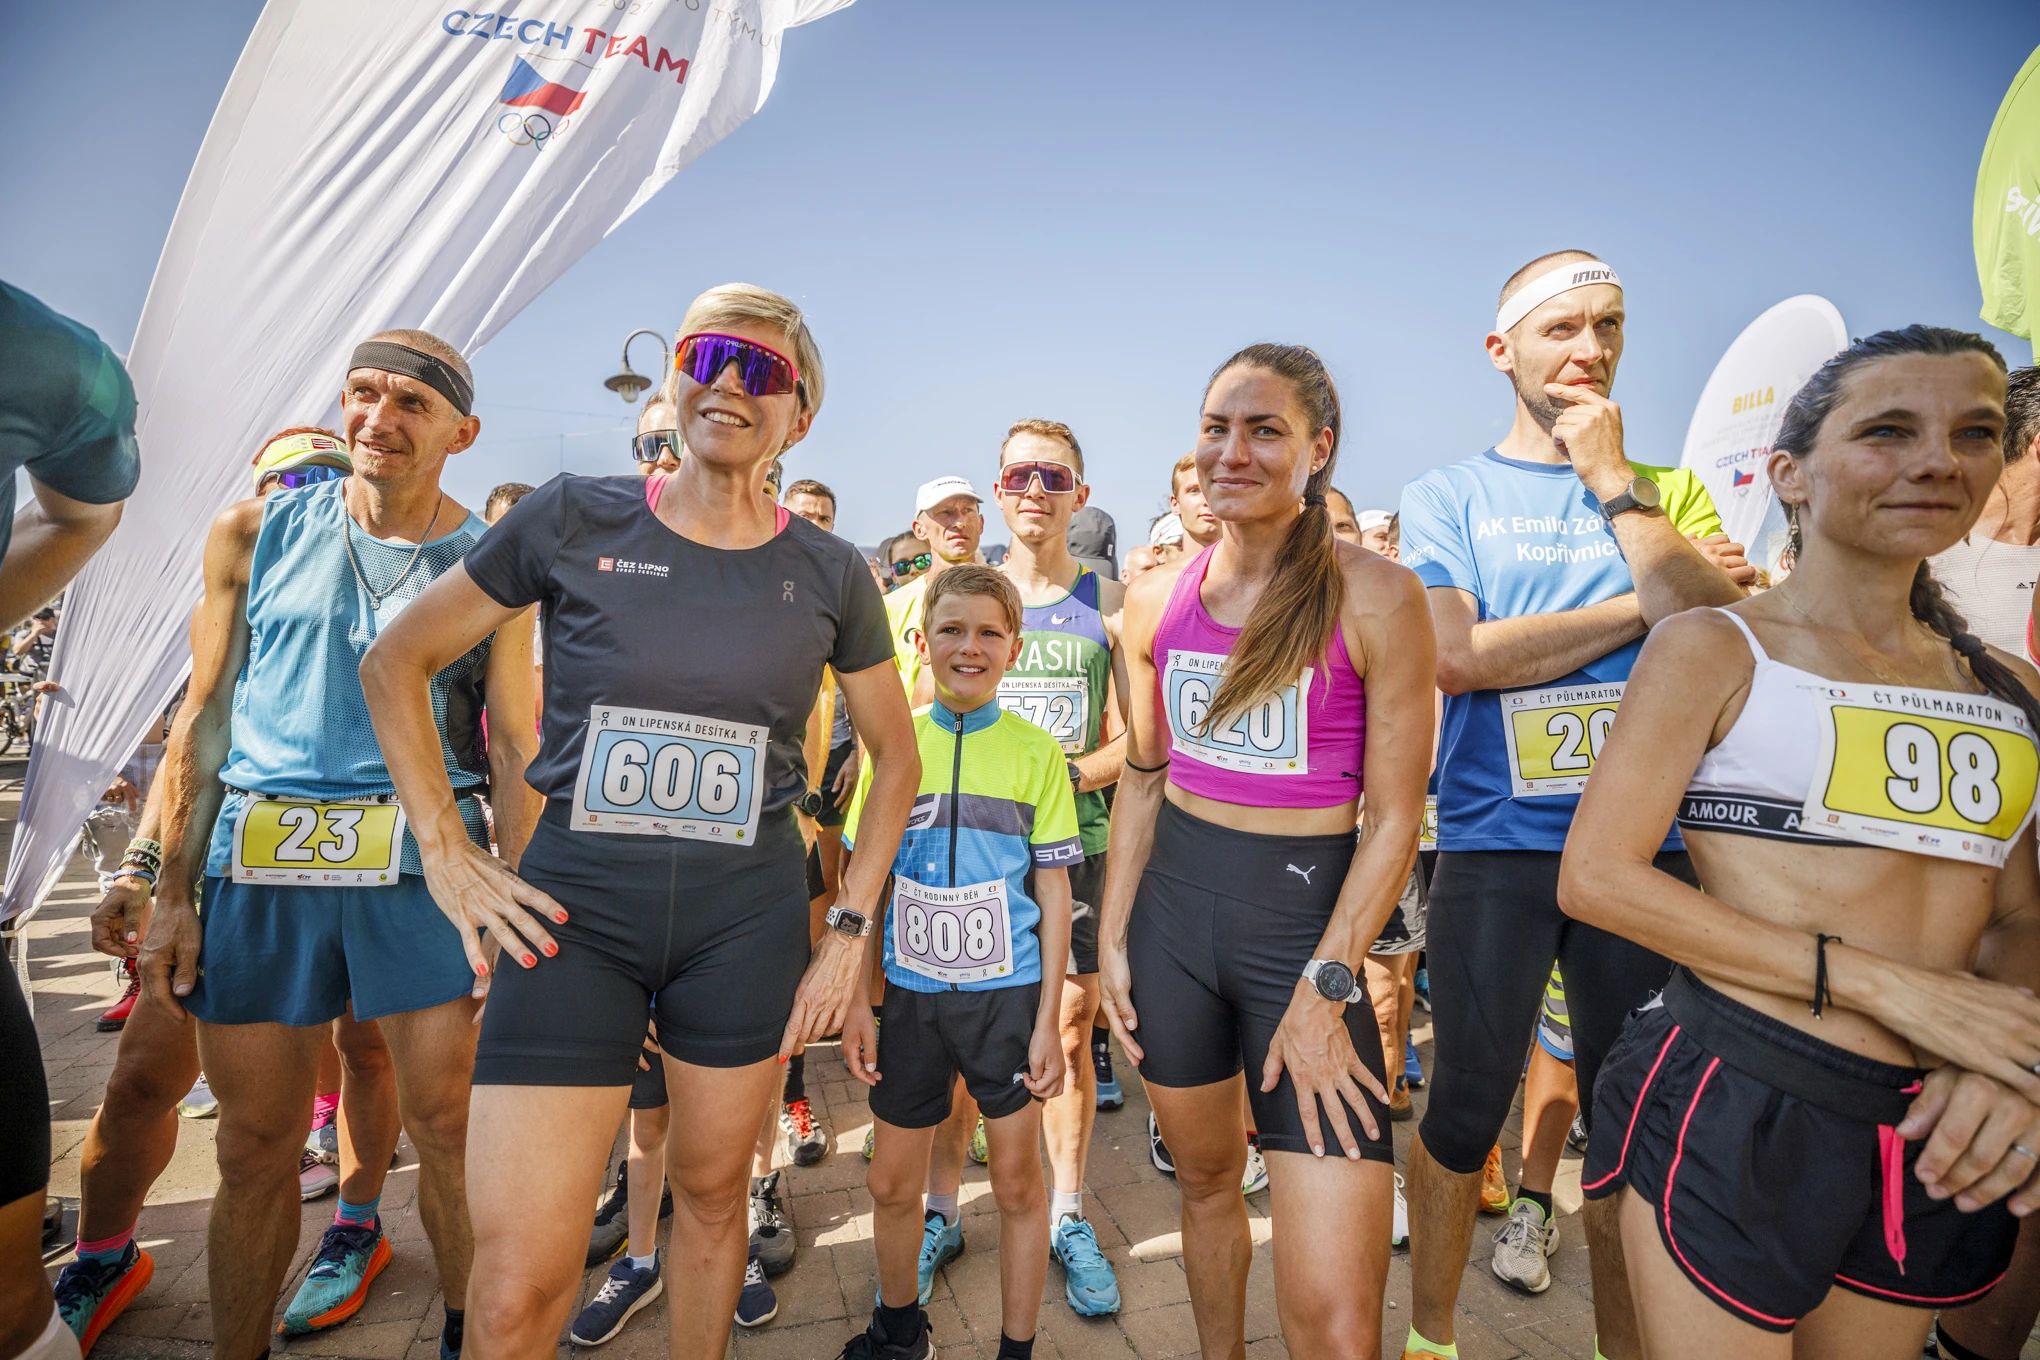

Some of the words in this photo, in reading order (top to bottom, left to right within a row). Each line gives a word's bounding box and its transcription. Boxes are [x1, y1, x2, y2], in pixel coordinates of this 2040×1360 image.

[442, 9, 574, 50] CZECH
[583, 27, 690, 85] TEAM
[1732, 385, 1775, 415] BILLA
[1477, 517, 1508, 540] AK
[616, 558, 637, 569] ČEZ
[638, 562, 670, 573] LIPNO
[1516, 540, 1620, 565] Kopřivnic
[1189, 657, 1200, 669] ON
[1539, 694, 1551, 704] ČT
[1557, 688, 1622, 703] PŮLMARATON
[1873, 691, 1894, 703] ČT
[1902, 692, 2004, 723] PŮLMARATON
[622, 715, 636, 727] ON
[640, 718, 692, 733] LIPENSKÁ
[695, 725, 738, 740] DESÍTKA
[1546, 708, 1618, 771] 20
[602, 739, 741, 816] 606
[1884, 722, 2003, 825] 98
[1688, 801, 1760, 826] AMOUR
[274, 806, 365, 863] 23
[914, 889, 922, 897] ČT
[924, 890, 961, 902] RODINNÝ
[905, 903, 996, 964] 808
